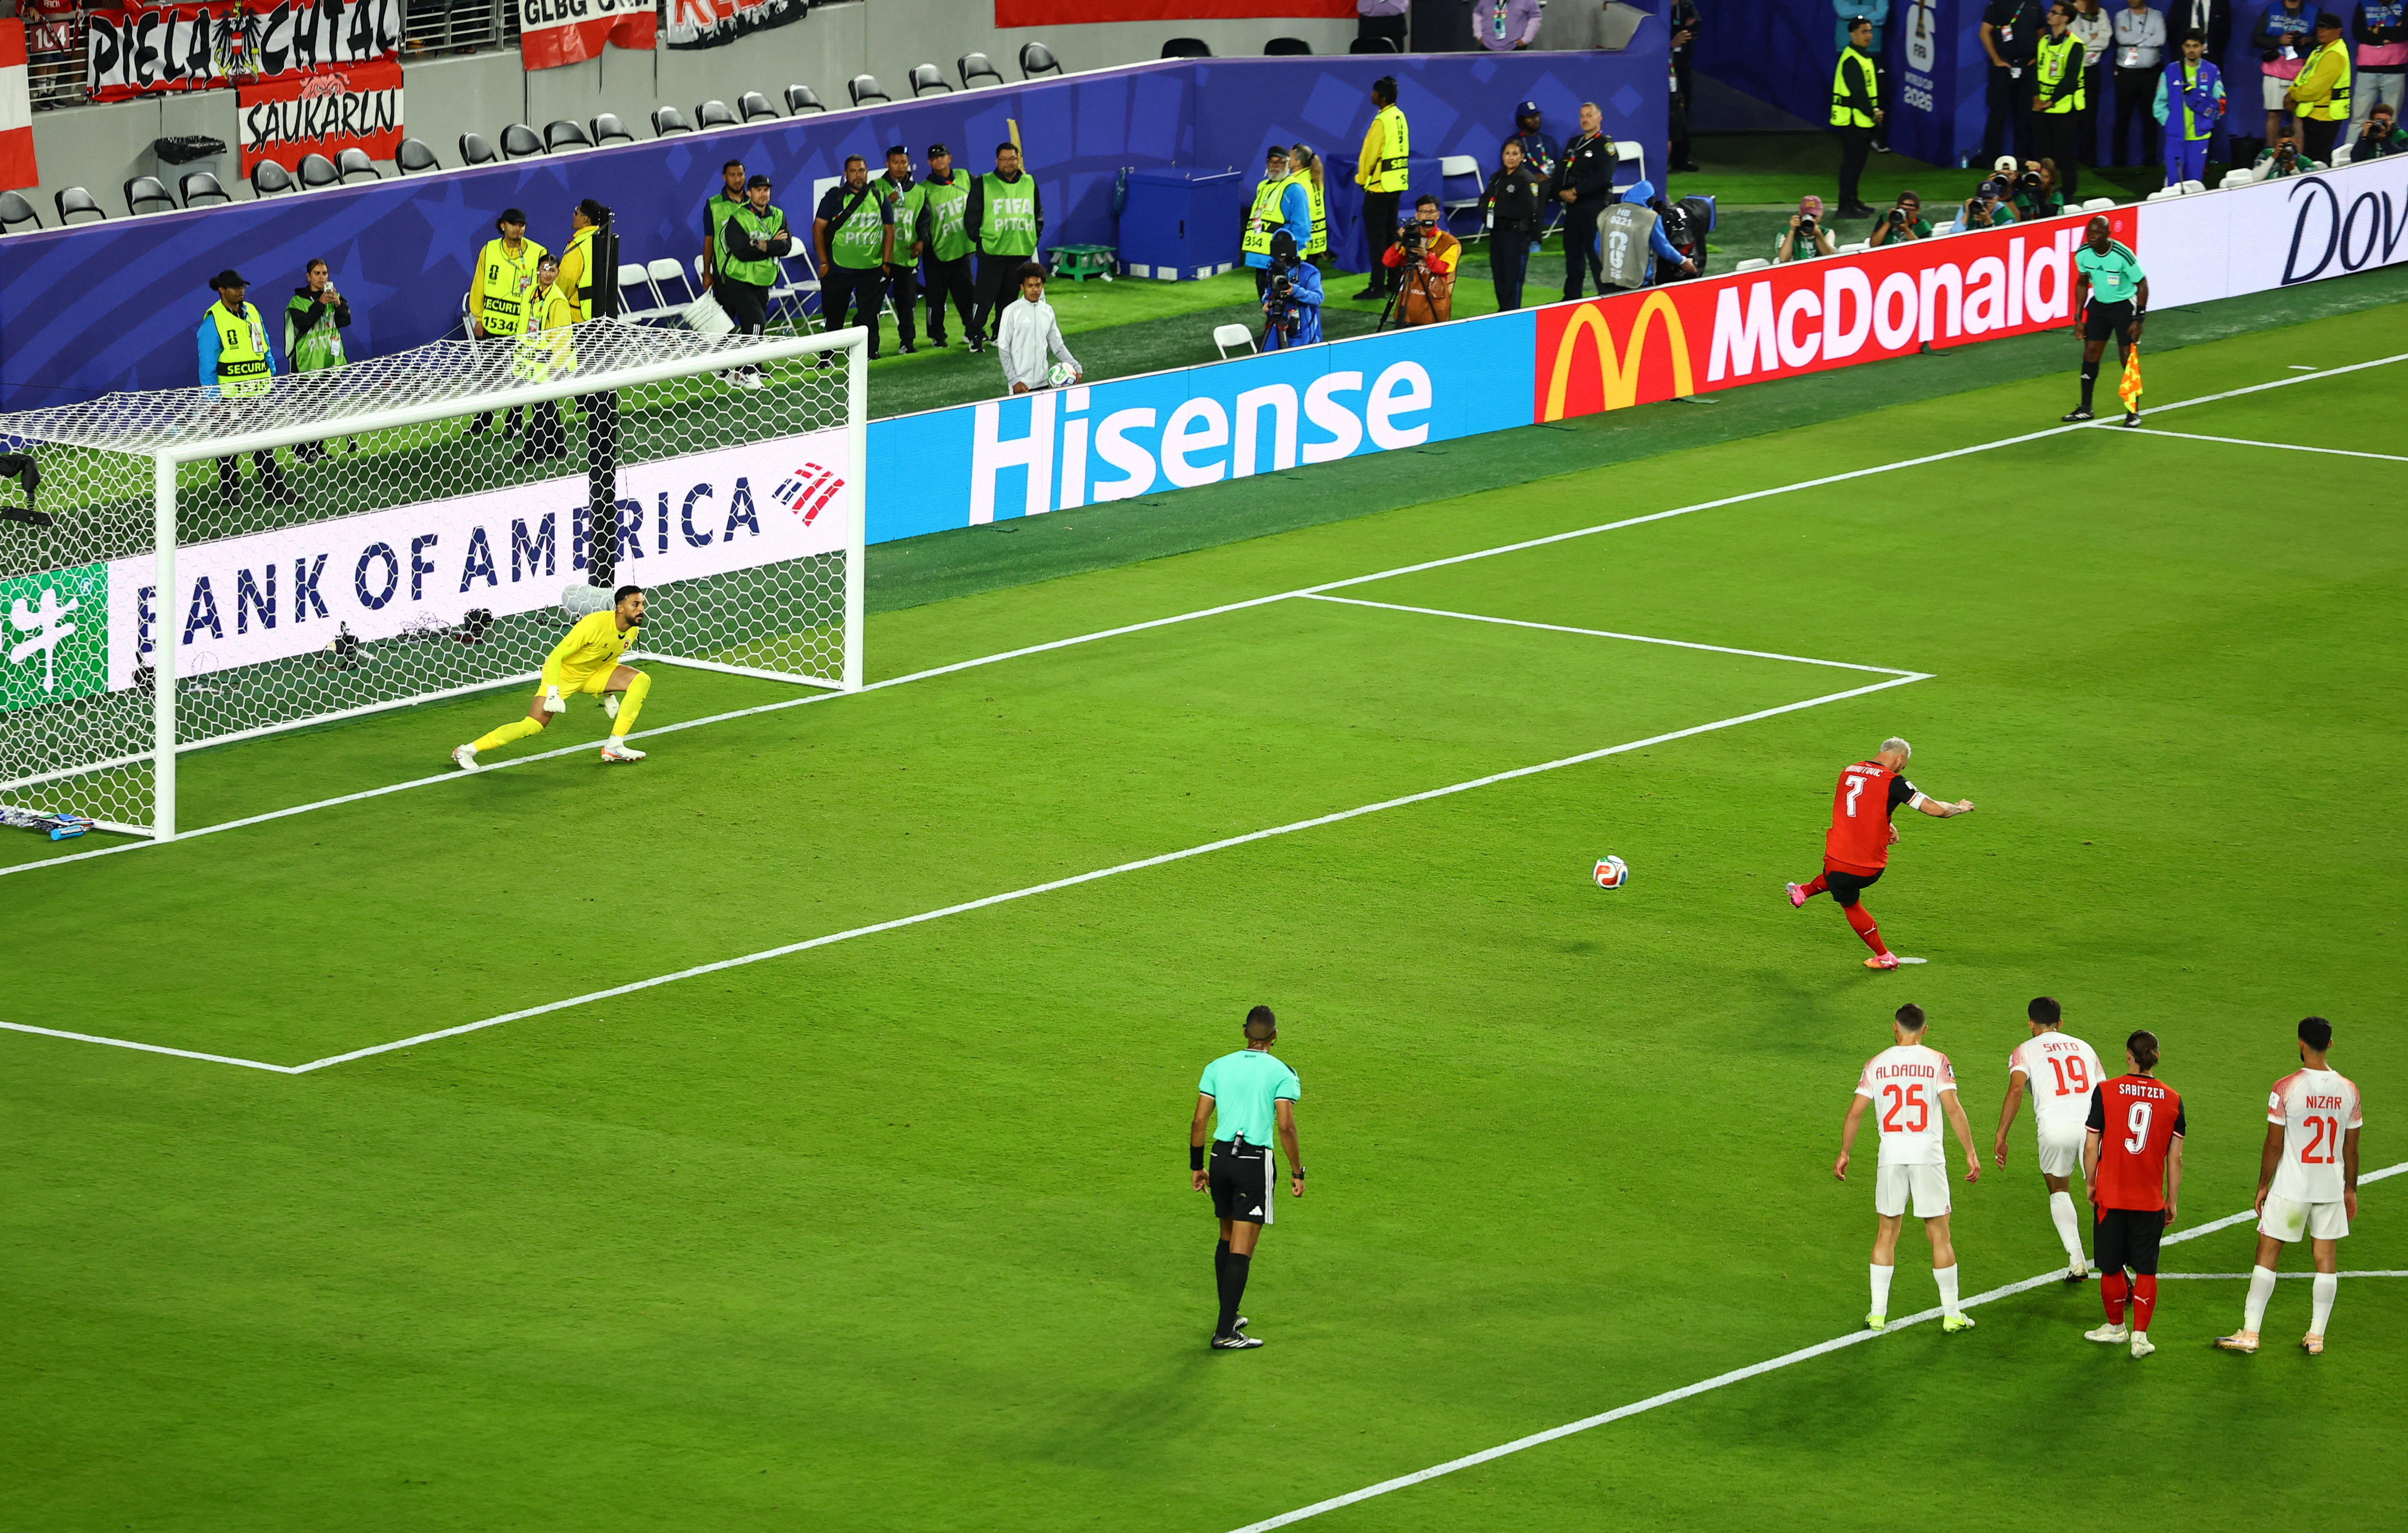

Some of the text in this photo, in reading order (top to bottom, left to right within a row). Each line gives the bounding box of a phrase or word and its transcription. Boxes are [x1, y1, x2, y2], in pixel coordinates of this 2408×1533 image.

[1904, 86, 1933, 112] 2026
[993, 198, 1033, 215] FIFA
[994, 217, 1034, 231] PITCH
[1706, 225, 2095, 382] McDonald'
[968, 360, 1433, 526] Hisense
[355, 533, 440, 610] OF
[1845, 775, 1867, 817] 7
[2043, 1042, 2080, 1052] SA'ED
[1876, 1064, 1934, 1080] ALDAOUD
[2047, 1055, 2089, 1096] 19
[2119, 1083, 2165, 1100] SABITZER
[1883, 1084, 1928, 1132] 25
[2306, 1095, 2342, 1110] NIZAR
[2124, 1101, 2153, 1154] 9
[2301, 1116, 2338, 1163] 21
